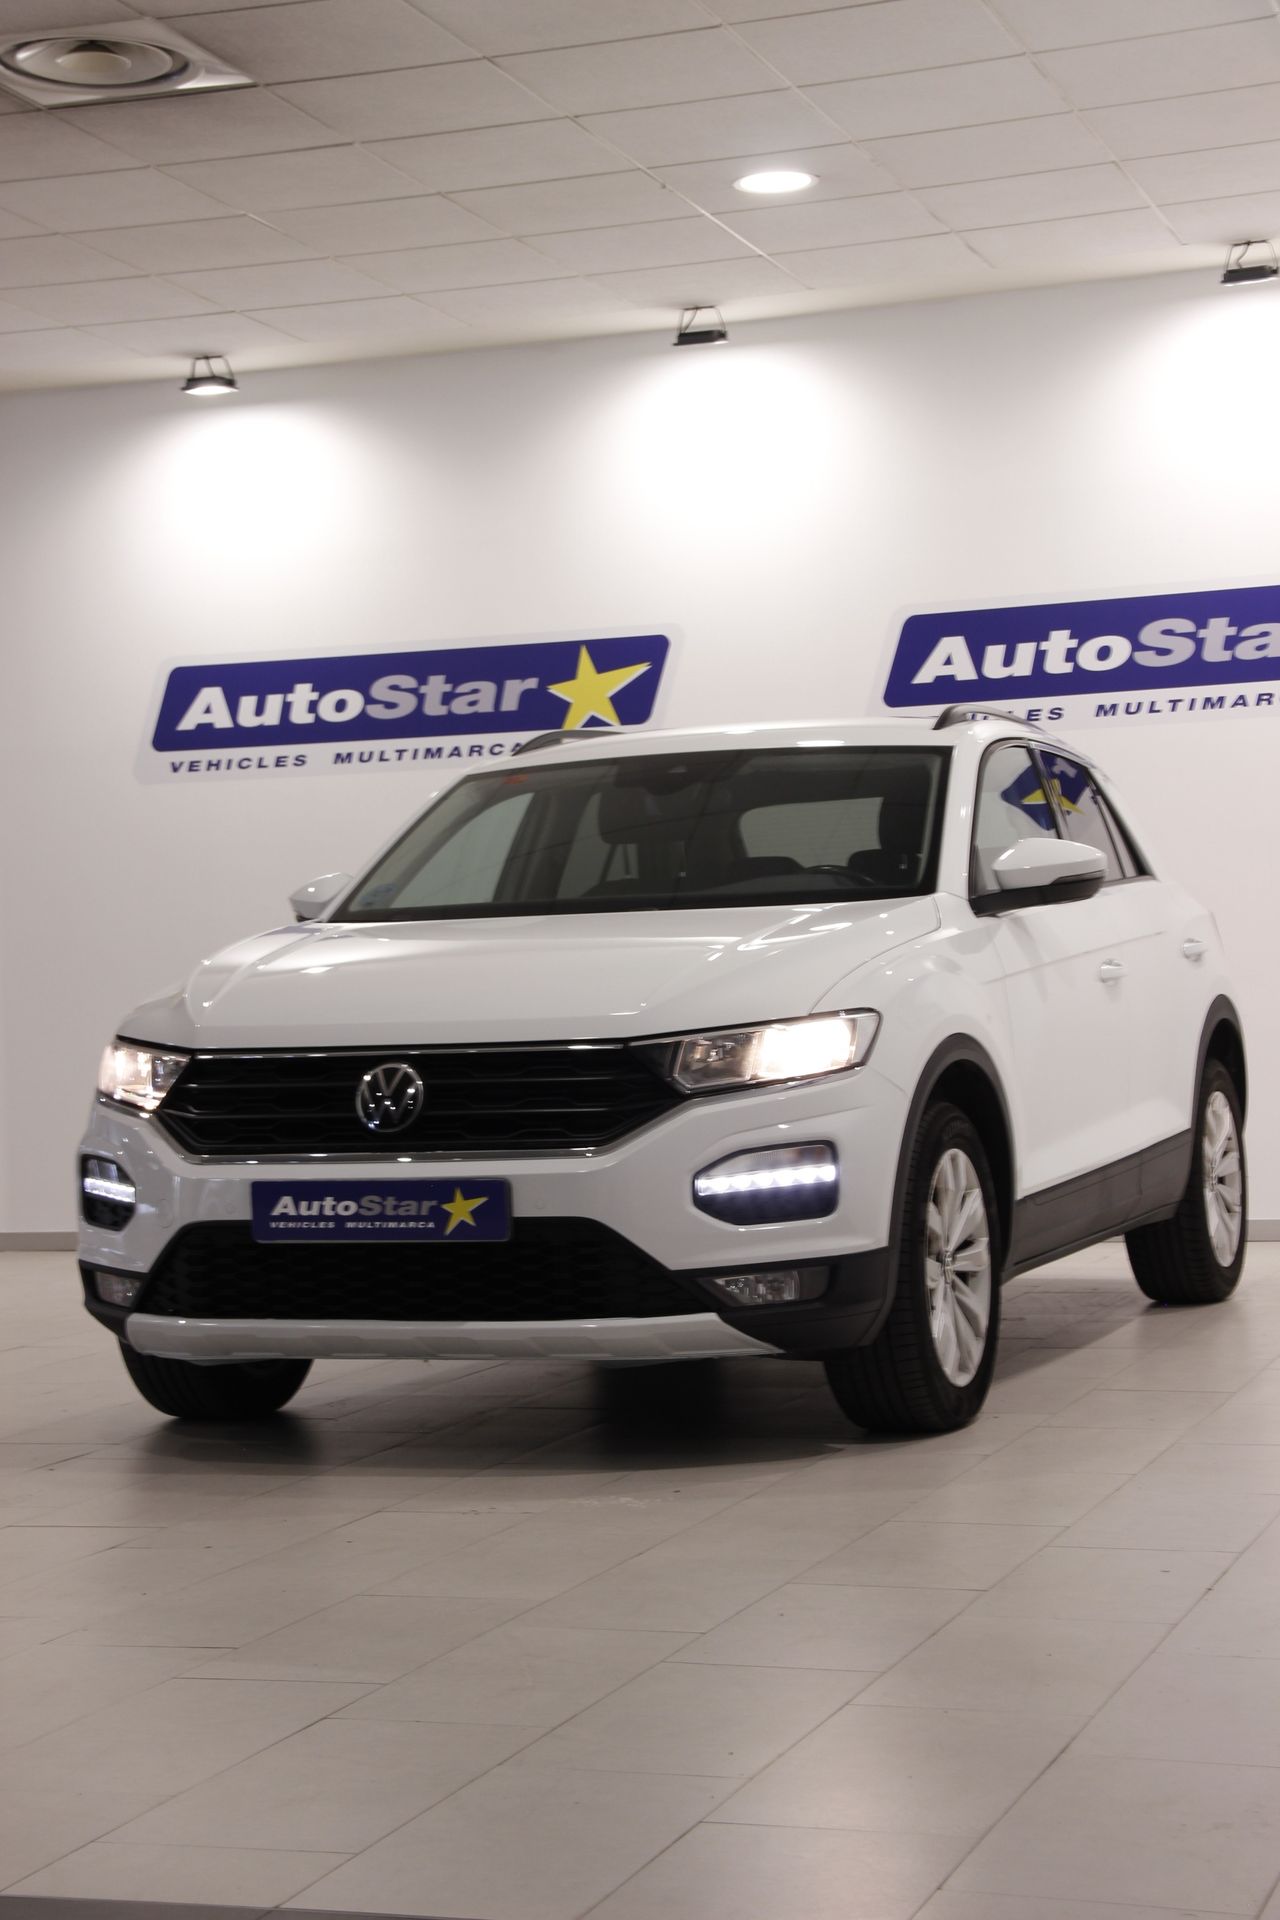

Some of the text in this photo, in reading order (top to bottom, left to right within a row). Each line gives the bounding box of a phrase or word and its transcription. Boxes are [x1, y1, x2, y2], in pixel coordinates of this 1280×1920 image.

[911, 617, 1280, 684] AutoSta
[175, 674, 538, 731] AutoStar
[1095, 692, 1280, 718] MULTIMAR
[170, 753, 308, 773] VEHICLES
[270, 1195, 437, 1216] AutoStar
[269, 1221, 436, 1229] VEHICLES MULTIMARCA
